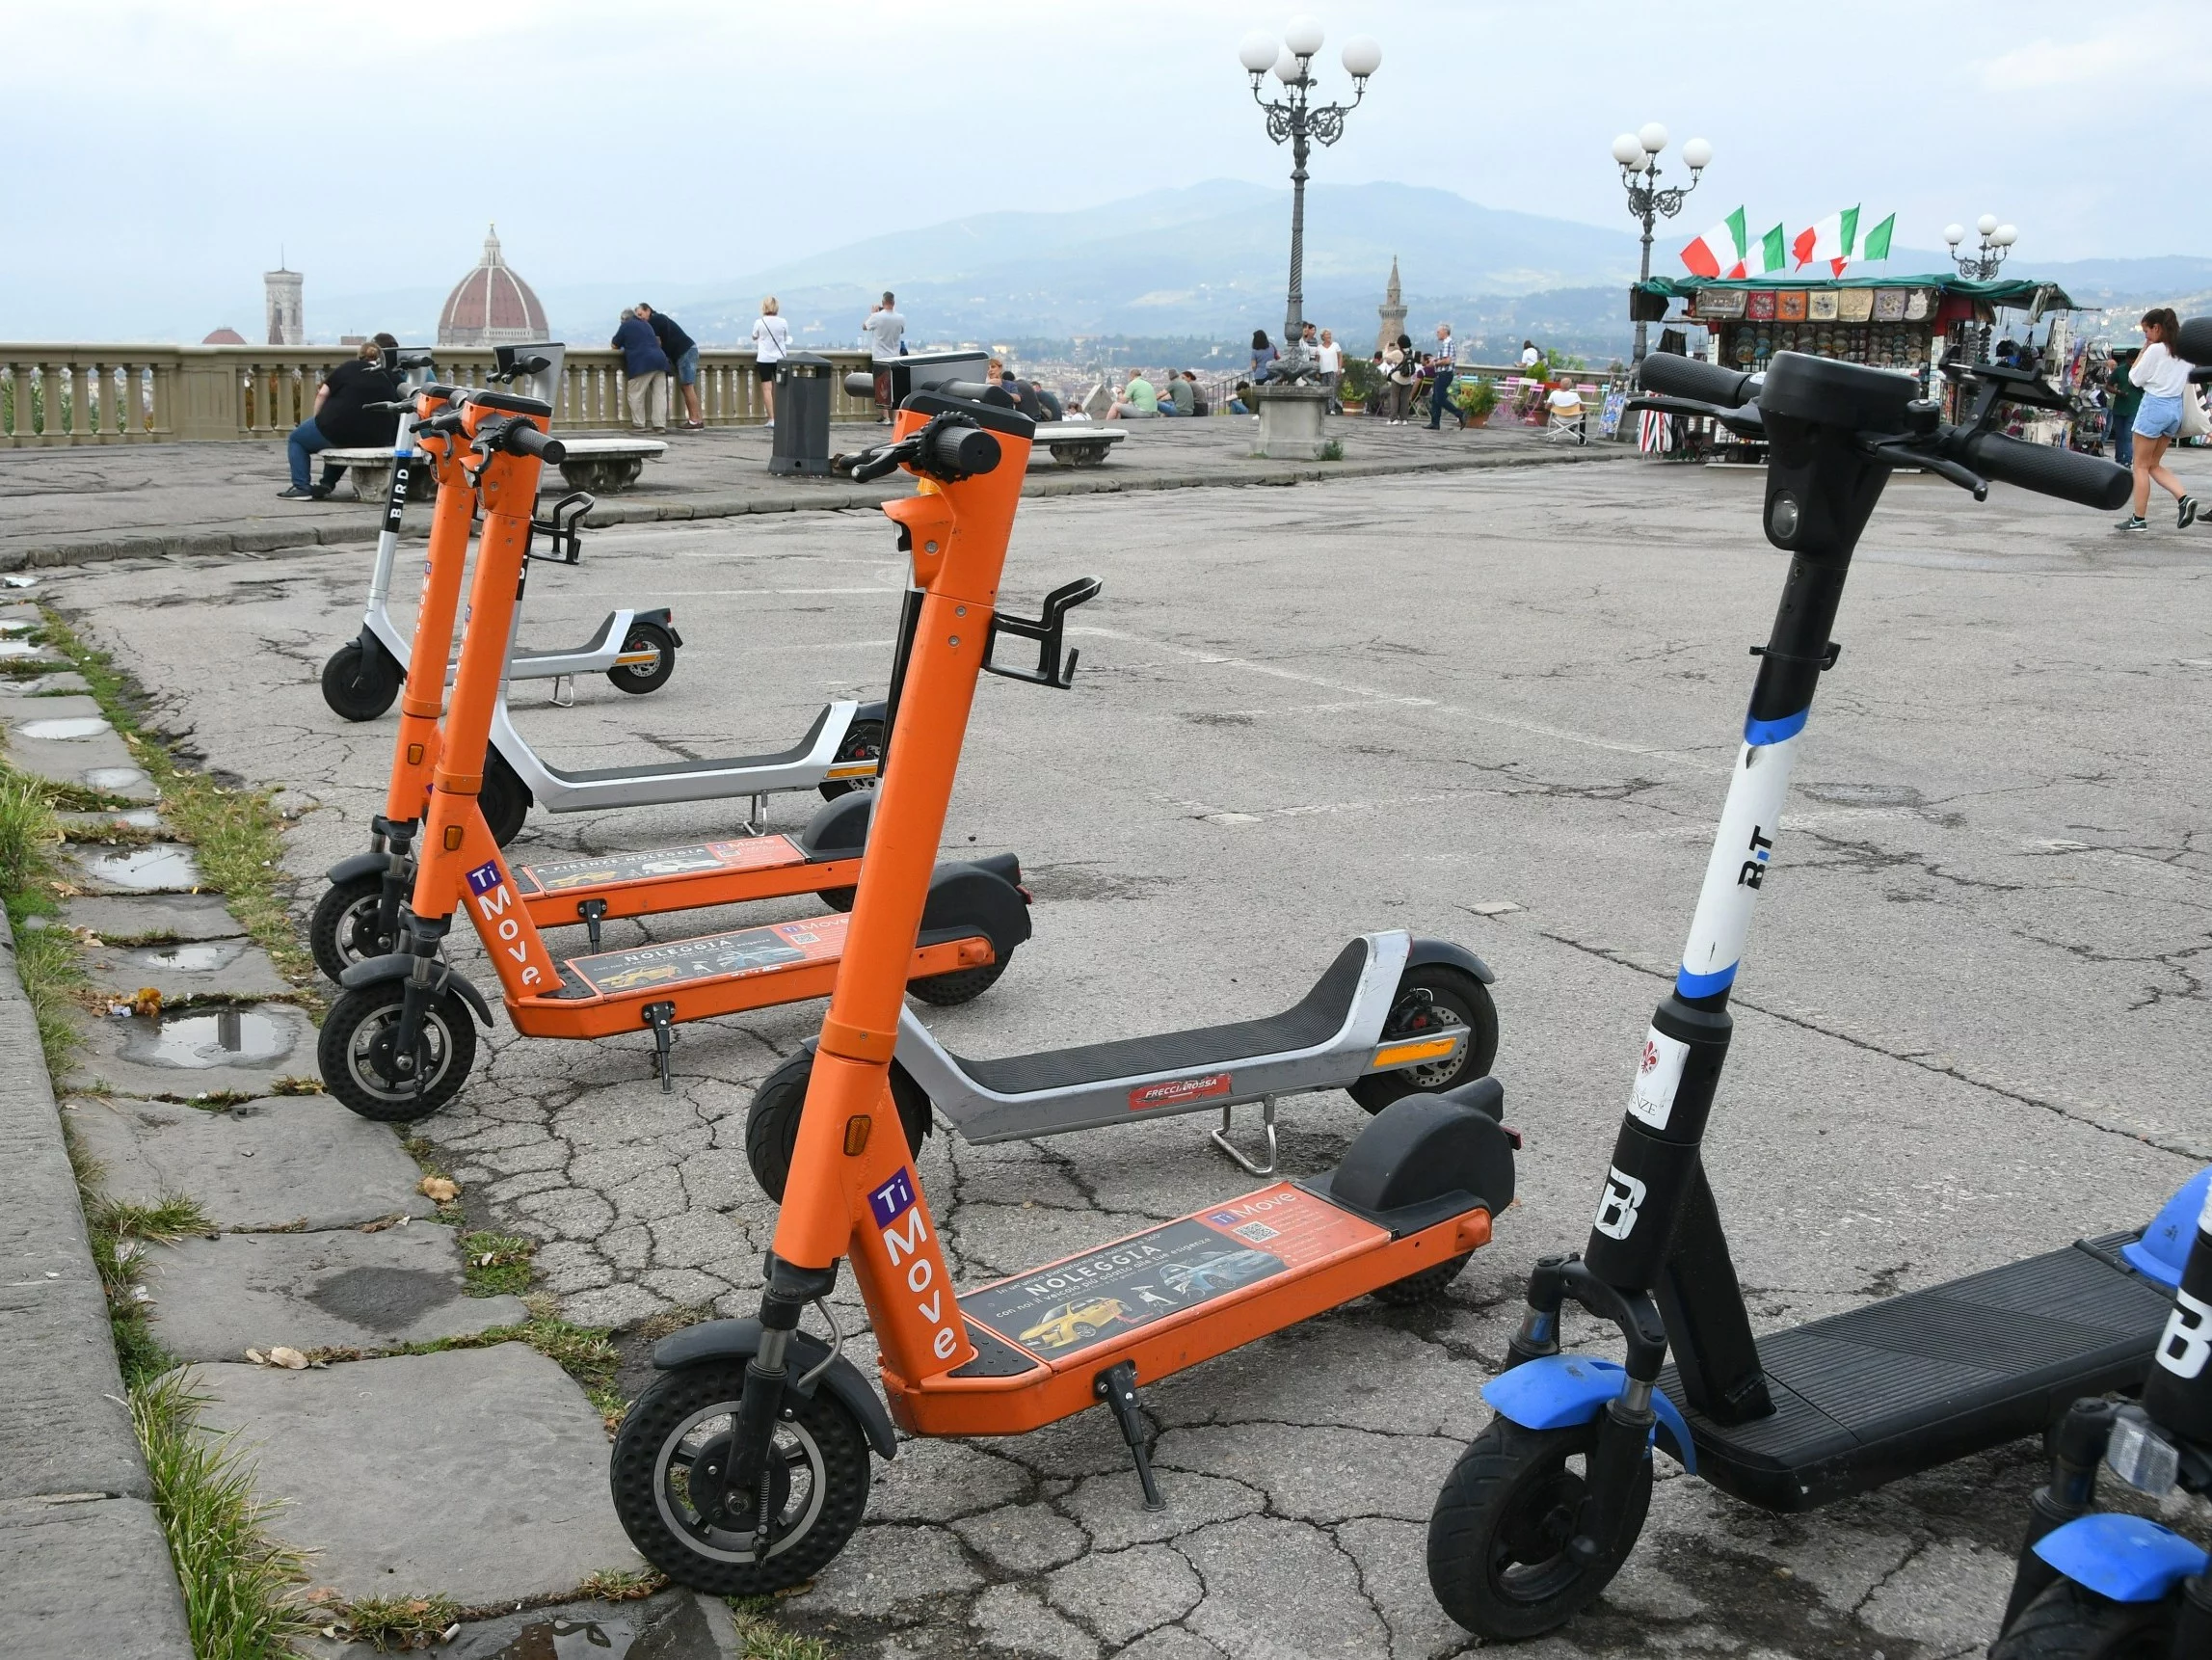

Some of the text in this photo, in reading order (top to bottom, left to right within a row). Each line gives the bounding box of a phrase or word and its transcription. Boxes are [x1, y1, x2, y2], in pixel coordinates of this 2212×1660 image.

[389, 469, 409, 519] BIRD
[472, 866, 541, 985] Ti Move
[625, 940, 732, 962] NOLEGGIA
[1211, 1213, 1236, 1223] Ti
[1230, 1192, 1296, 1218] Move
[1594, 1164, 1646, 1241] B
[877, 1178, 957, 1359] Ti Move
[996, 1307, 1017, 1319] con
[1017, 1299, 1034, 1311] noi
[1043, 1284, 1080, 1301] veicolo
[1100, 1266, 1133, 1281] adatto
[1133, 1258, 1153, 1269] alle
[1152, 1252, 1170, 1262] tue
[1170, 1236, 1213, 1255] esigenze
[1025, 1245, 1162, 1297] NOLEGGIA
[1046, 1257, 1095, 1279] piattaforma
[2155, 1286, 2212, 1379] B
